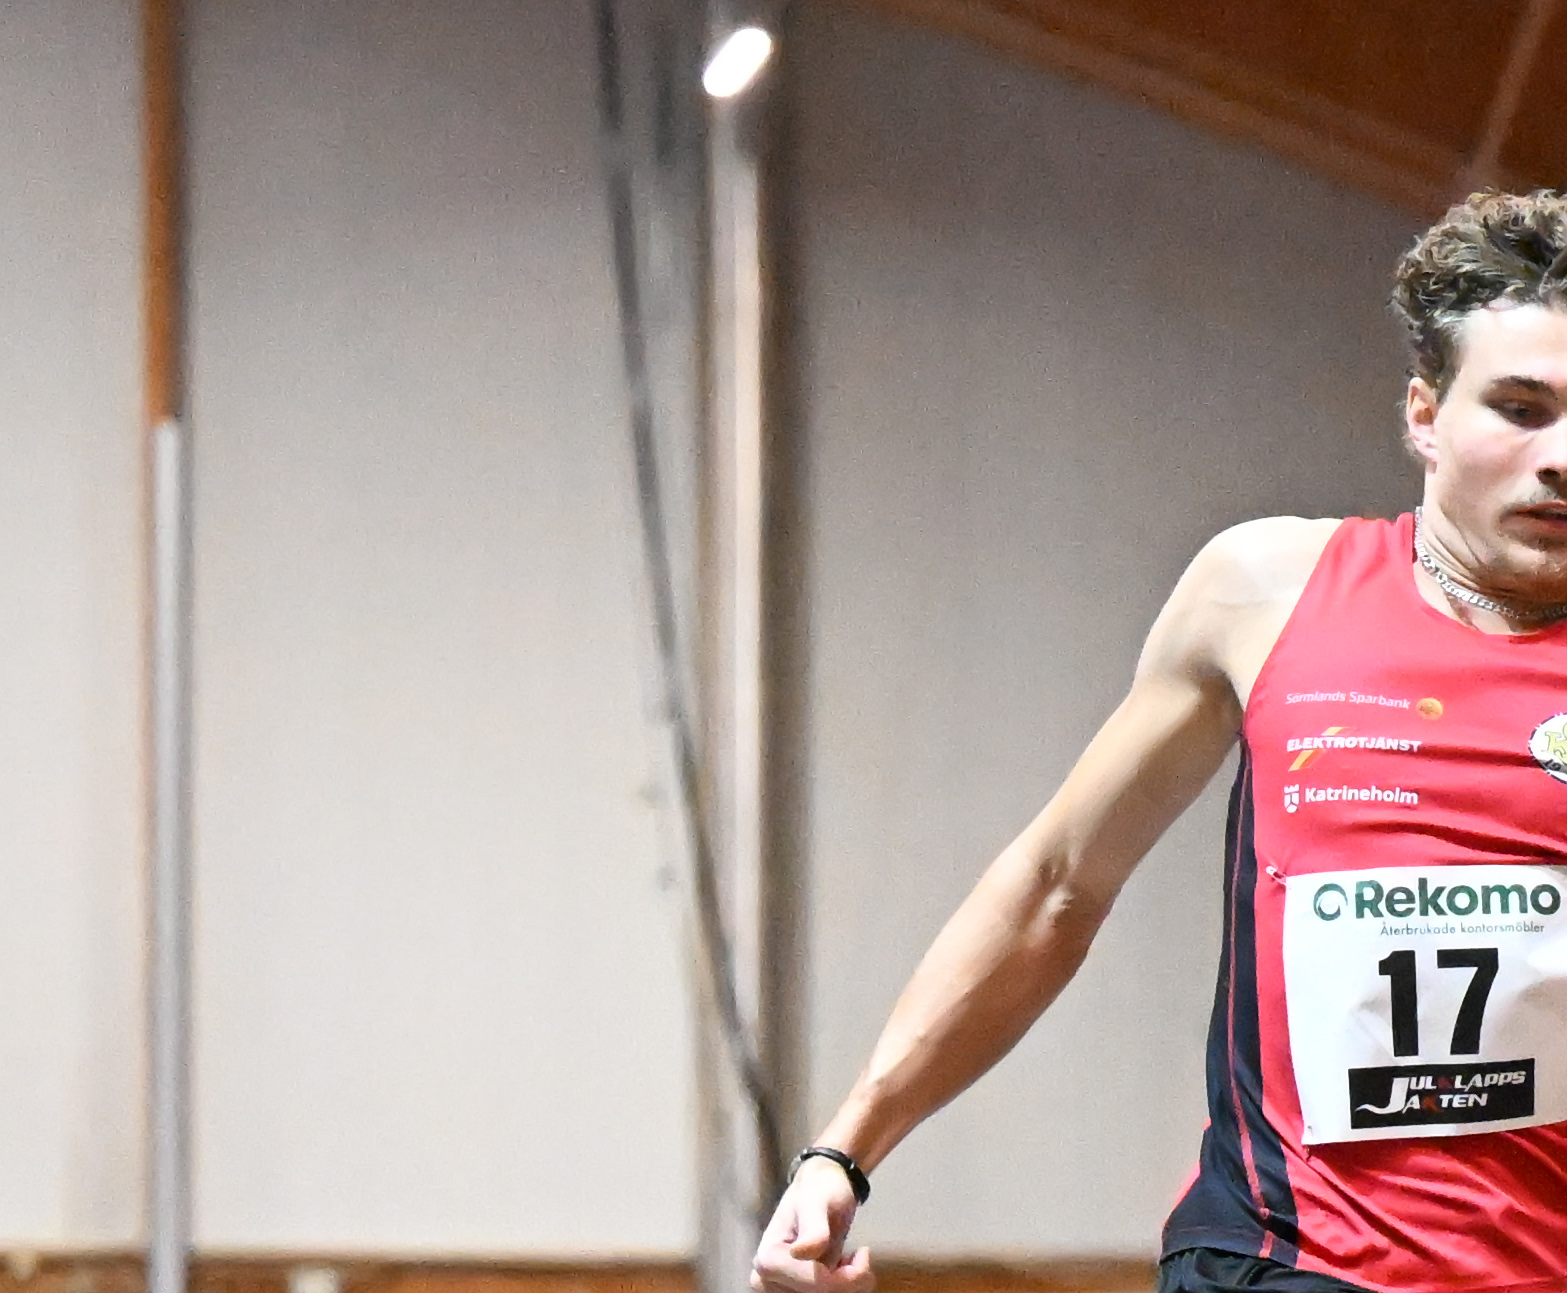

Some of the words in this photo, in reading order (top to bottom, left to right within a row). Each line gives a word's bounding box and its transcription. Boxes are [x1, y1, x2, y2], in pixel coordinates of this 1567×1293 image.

[1286, 690, 1346, 705] Sörmlands
[1350, 691, 1411, 709] Sparbank
[1287, 735, 1421, 753] ELEKTROTJÄNST
[1305, 786, 1418, 805] Katrineholm
[1355, 877, 1561, 918] Rekomo
[1380, 921, 1456, 936] Återbrukade
[1460, 920, 1544, 934] kontorsmöbler
[1379, 948, 1499, 1057] 17
